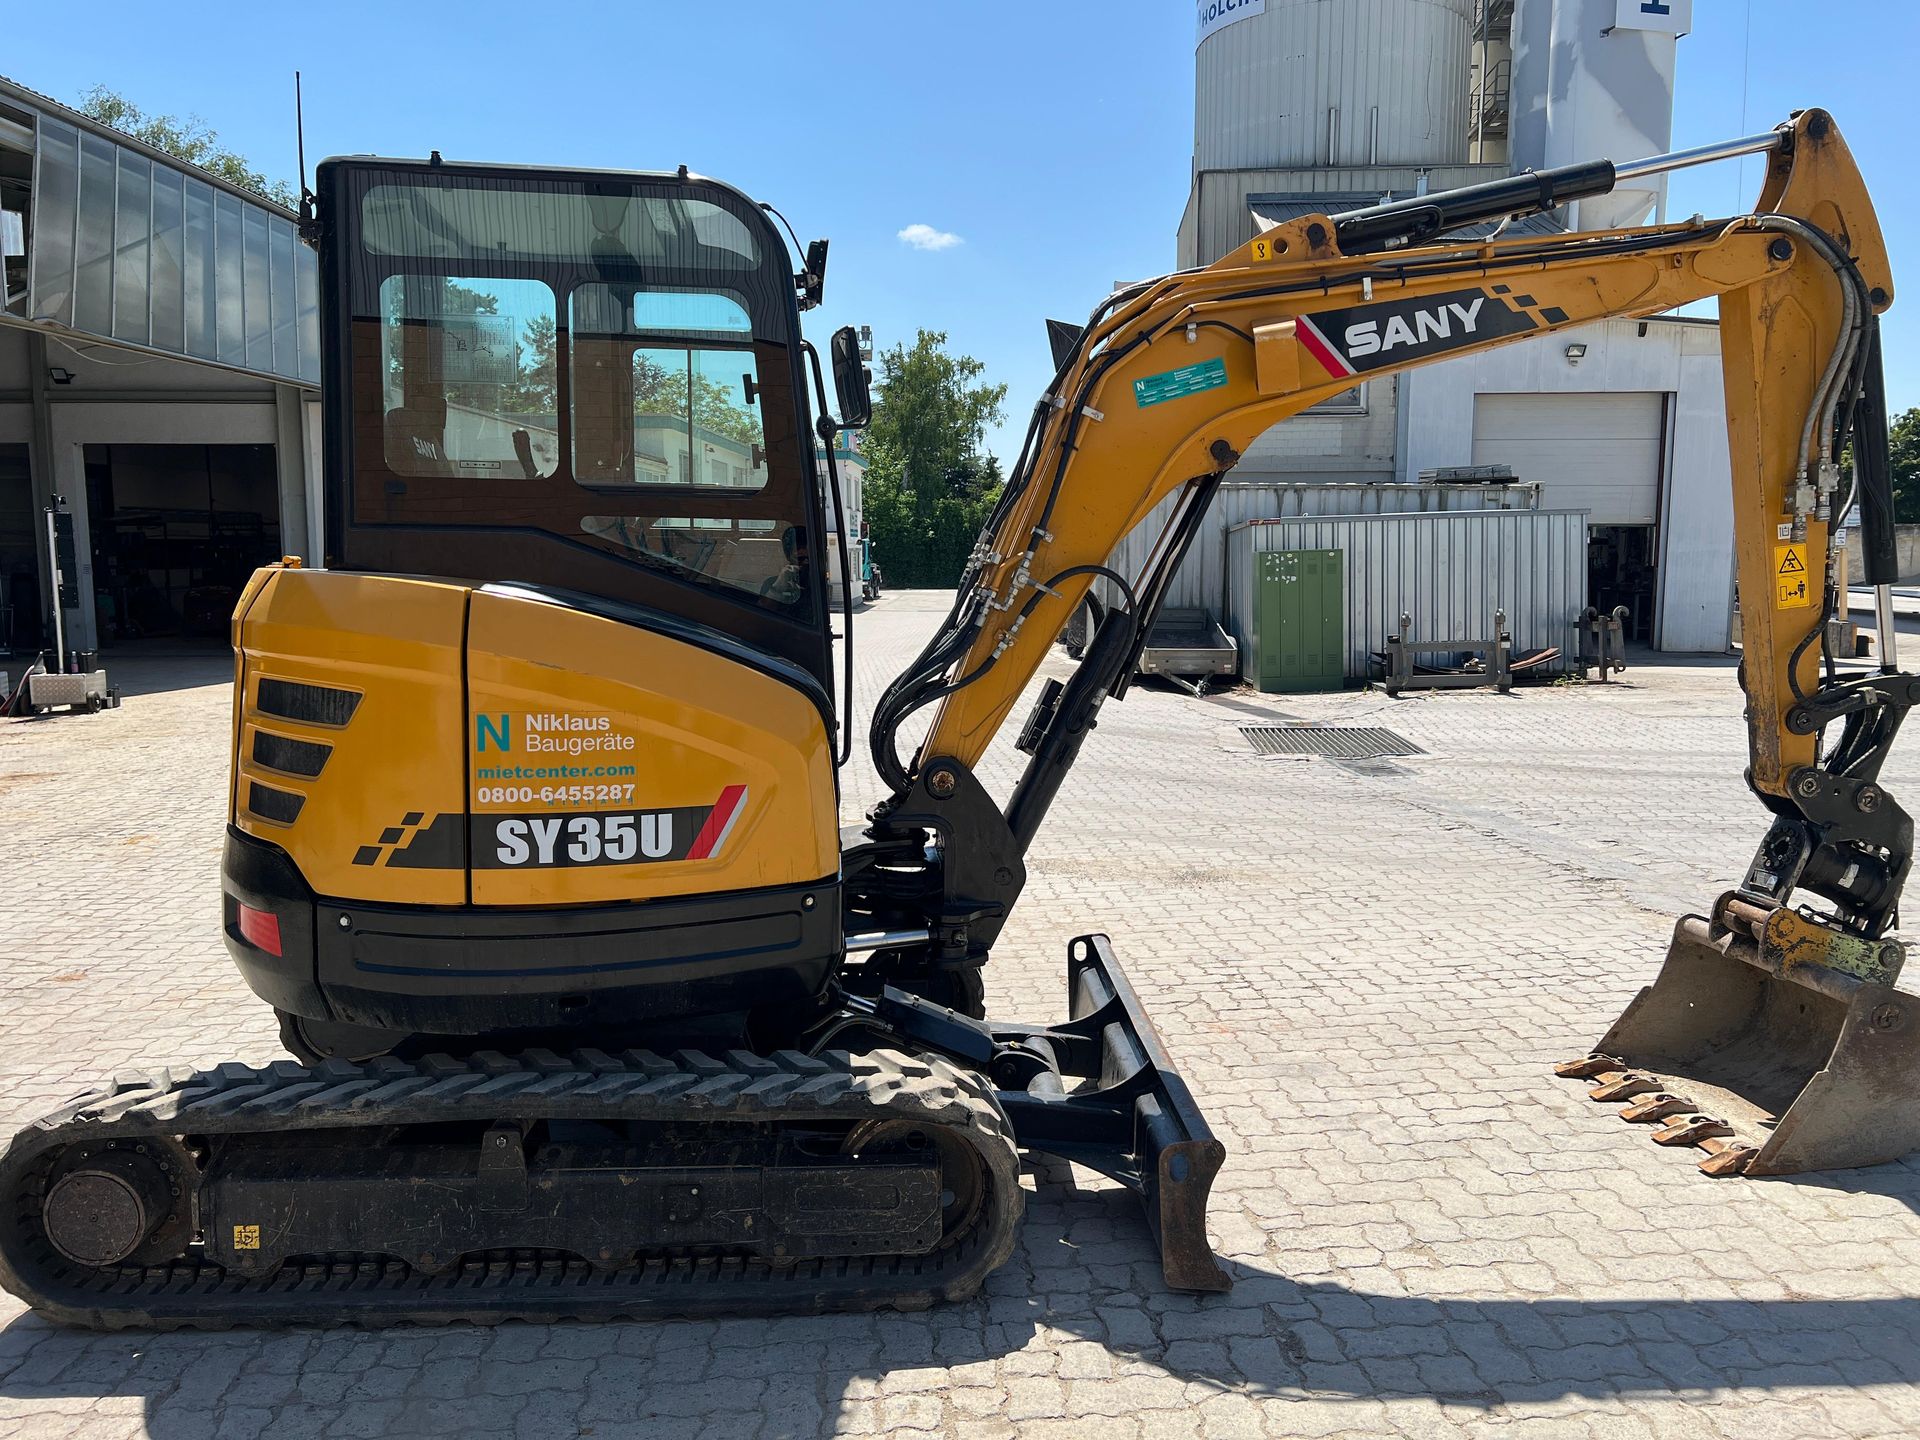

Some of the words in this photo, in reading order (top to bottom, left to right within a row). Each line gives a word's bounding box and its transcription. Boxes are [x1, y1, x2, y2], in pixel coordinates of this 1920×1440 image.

[1202, 0, 1259, 28] HOLC
[1345, 297, 1485, 358] SANY
[476, 714, 510, 752] N
[525, 713, 611, 732] Niklaus
[525, 733, 636, 756] Baugeräte
[477, 764, 636, 779] mietcenter.com
[477, 783, 636, 803] 0800-6455287
[496, 813, 673, 865] SY35U
